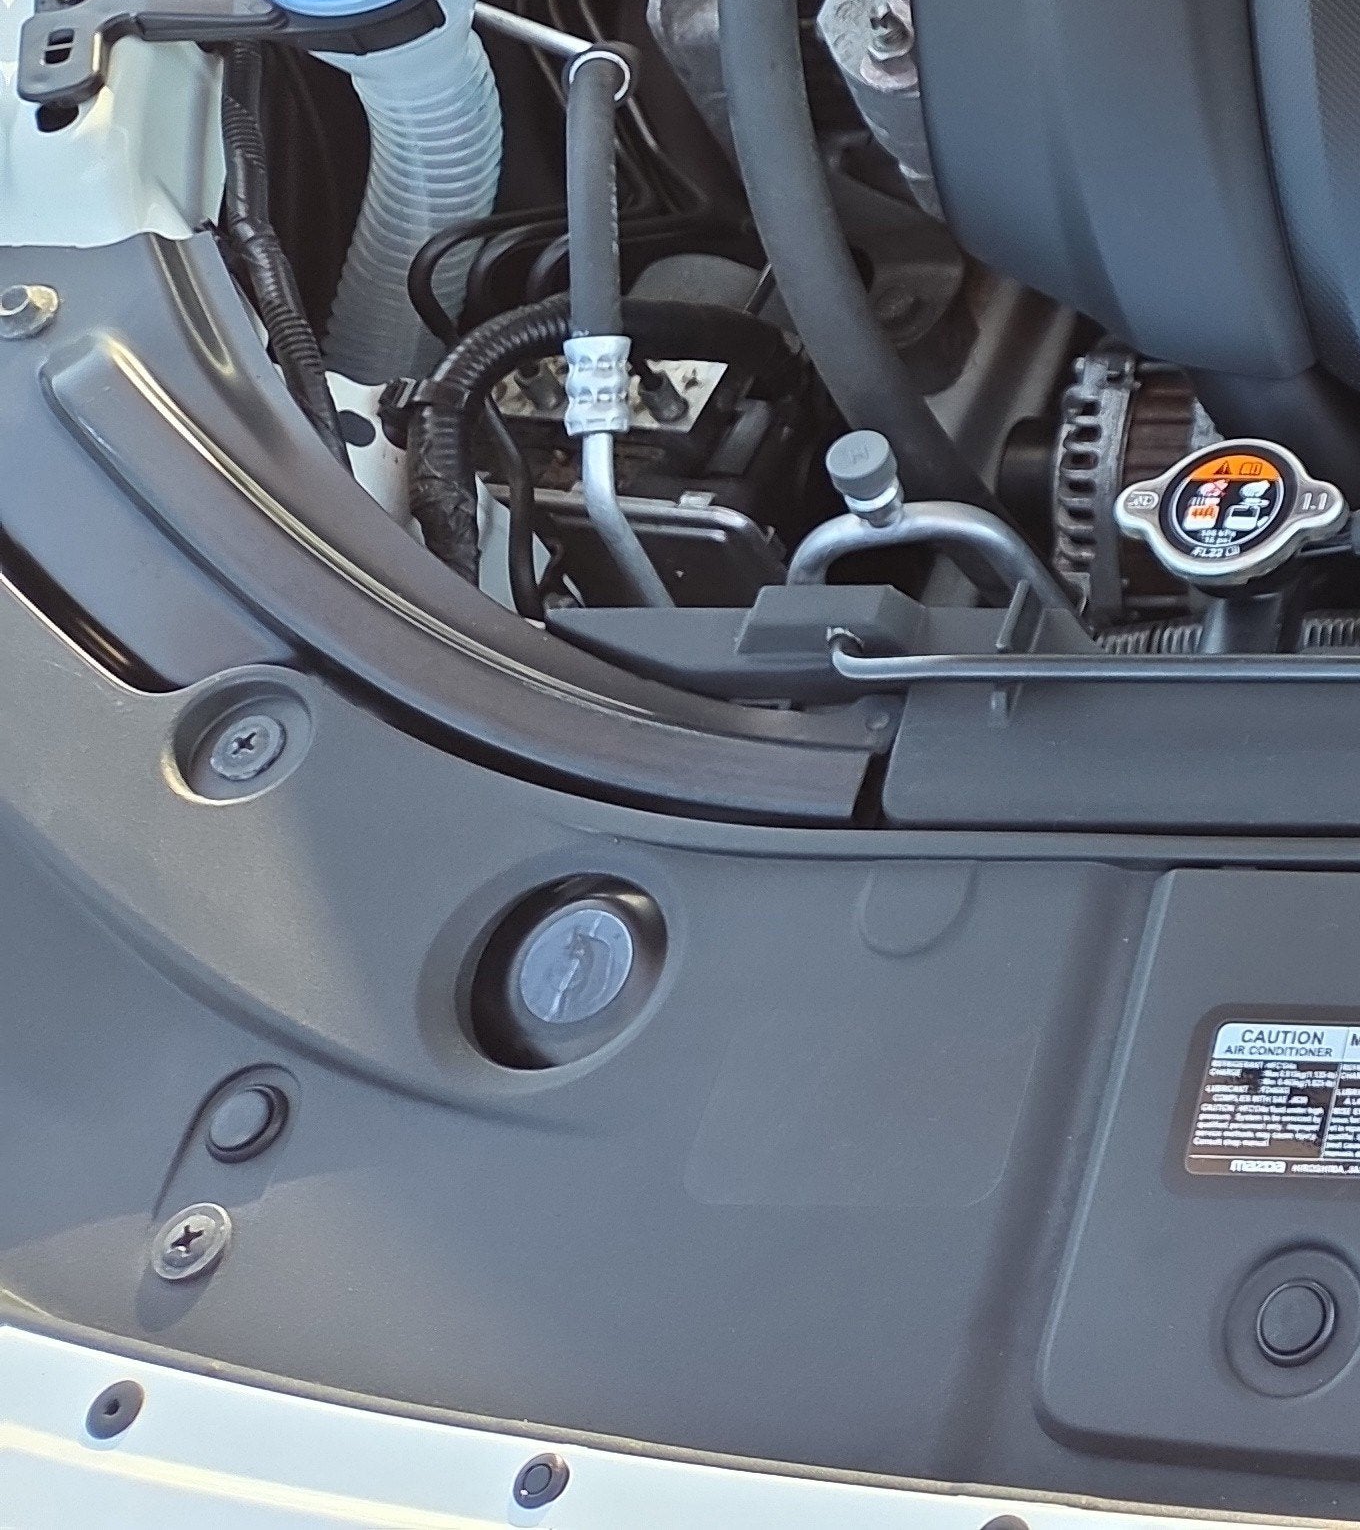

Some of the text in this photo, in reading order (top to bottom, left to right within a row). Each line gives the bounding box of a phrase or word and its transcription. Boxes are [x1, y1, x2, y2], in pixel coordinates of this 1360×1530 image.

[1240, 1029, 1325, 1045] CAUTION
[1224, 1045, 1333, 1057] AIR CONDITIONER
